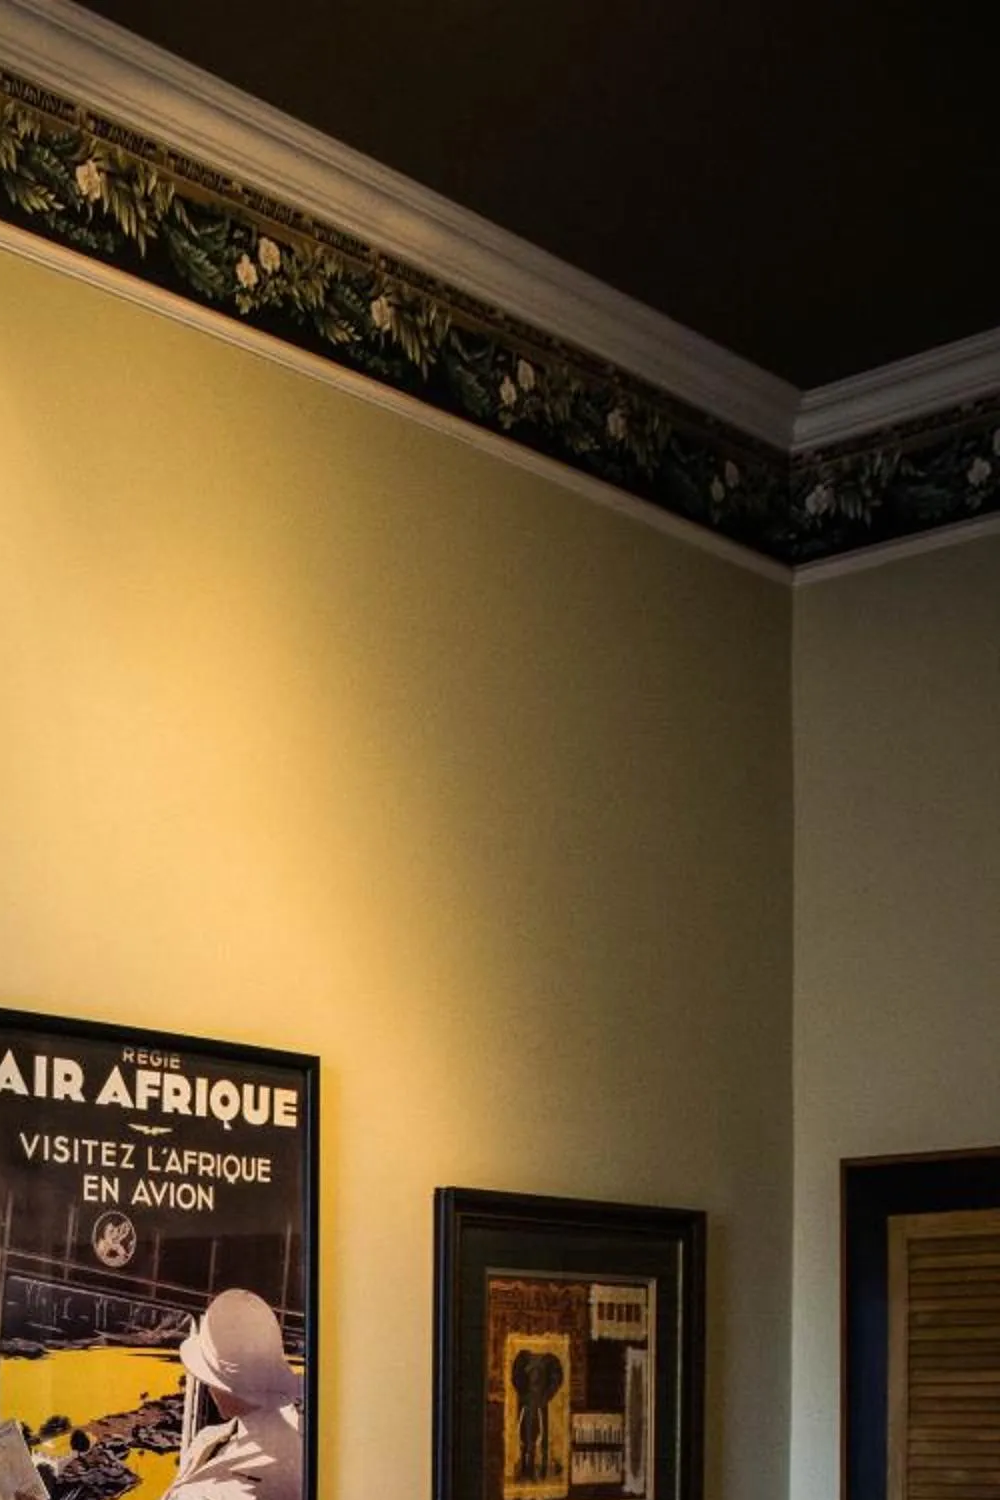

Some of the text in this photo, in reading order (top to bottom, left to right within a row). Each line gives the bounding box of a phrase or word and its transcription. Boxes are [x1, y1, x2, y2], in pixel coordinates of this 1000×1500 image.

[95, 1065, 298, 1131] AFRIQUE
[20, 1133, 272, 1184] VISITEZ L'AFRIQUE
[83, 1175, 215, 1212] EN AVION
